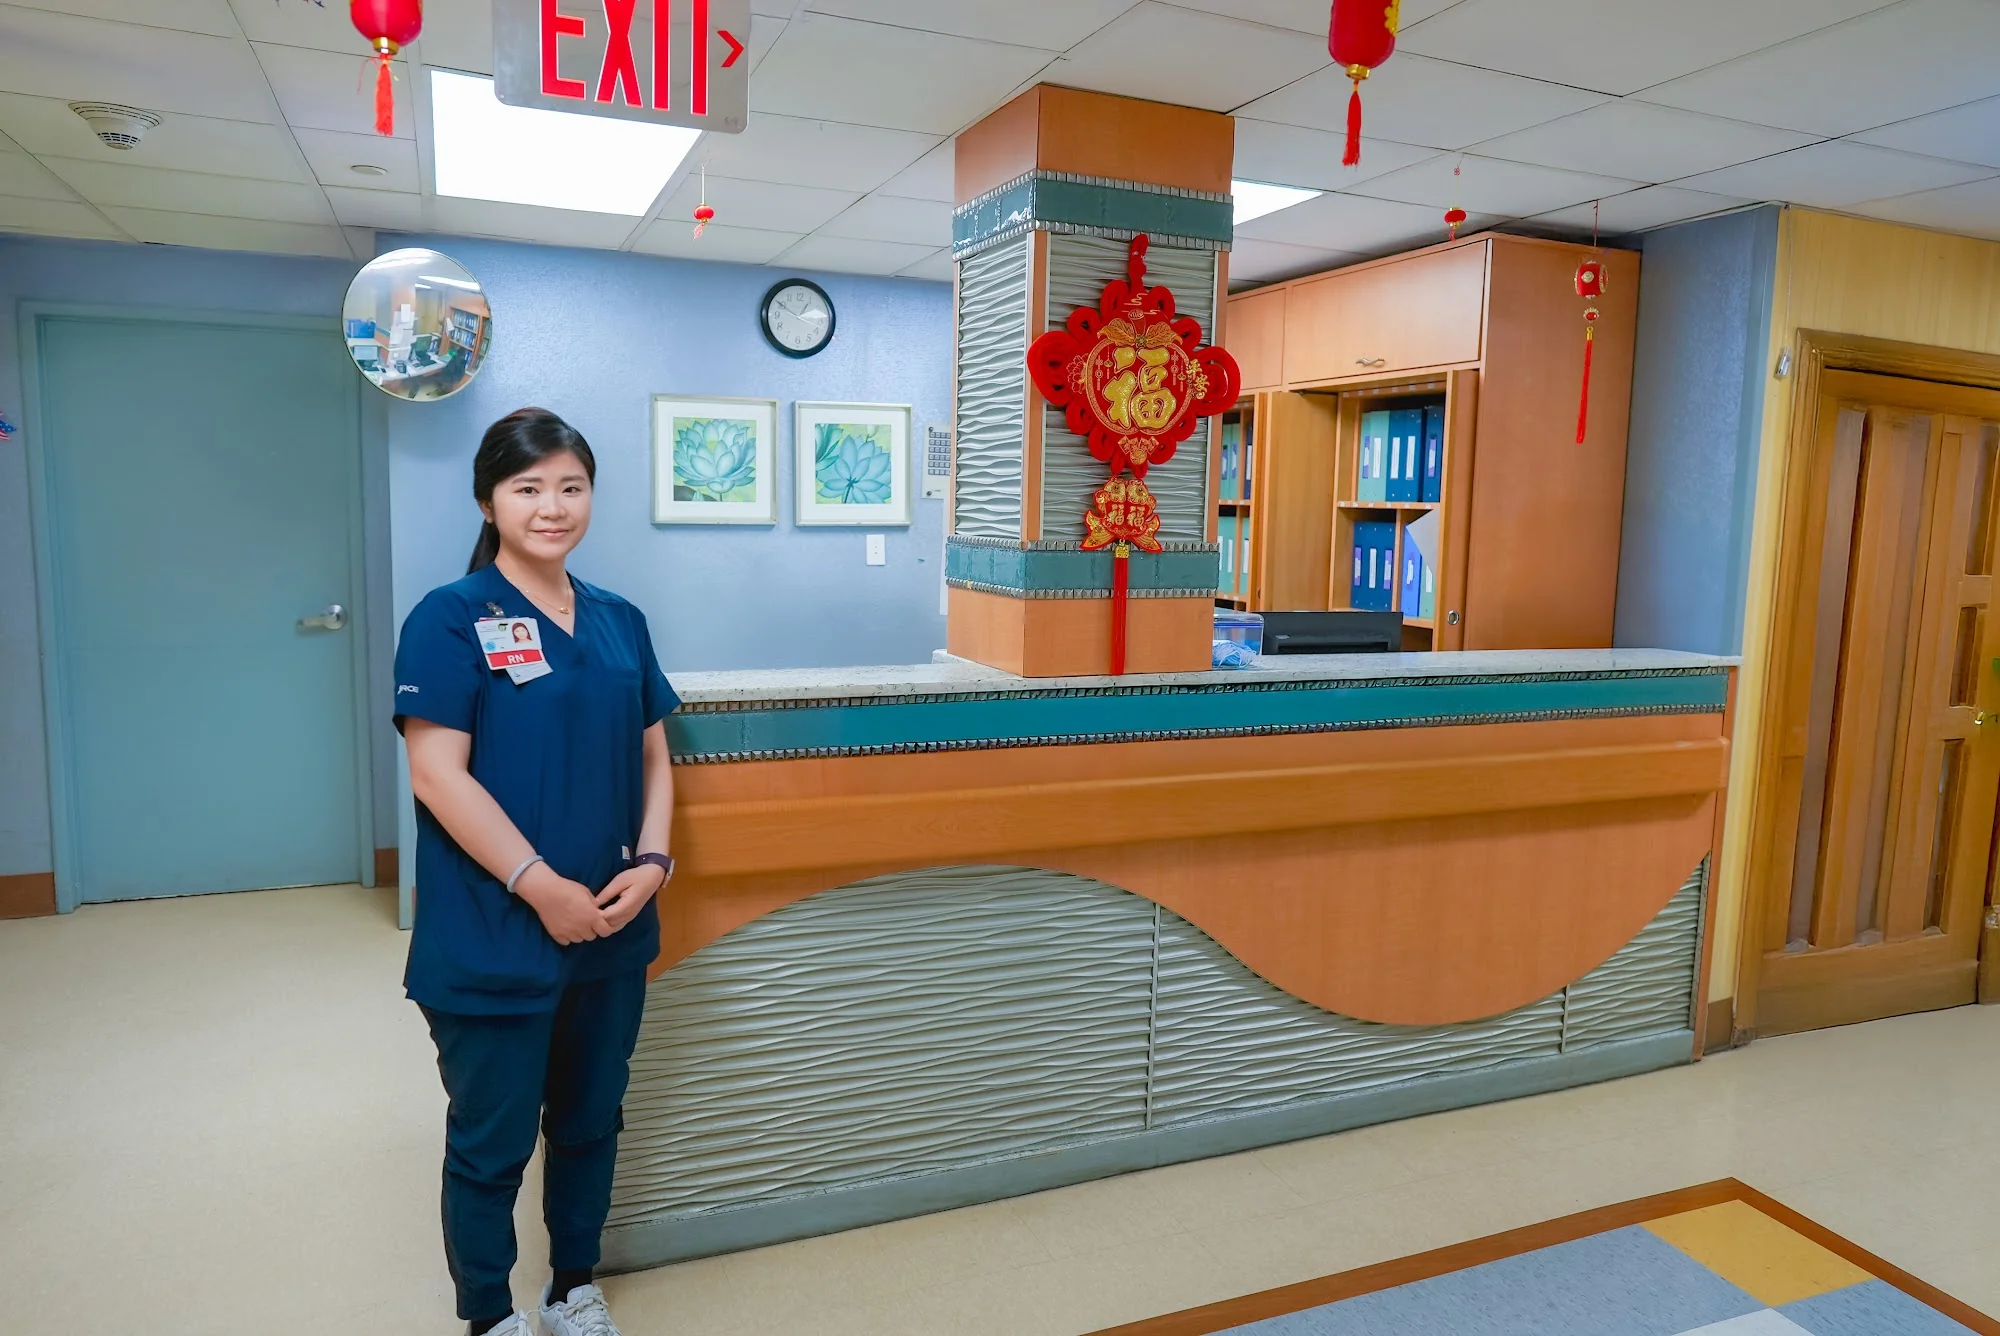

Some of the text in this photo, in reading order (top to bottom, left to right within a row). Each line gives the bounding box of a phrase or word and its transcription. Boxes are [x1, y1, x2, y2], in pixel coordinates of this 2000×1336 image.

[796, 292, 804, 301] 12
[774, 311, 780, 319] 9
[776, 321, 783, 331] 8
[813, 326, 820, 336] 4
[794, 335, 801, 345] 6
[805, 333, 812, 343] 5
[1102, 345, 1177, 430] 福
[507, 653, 525, 664] RN
